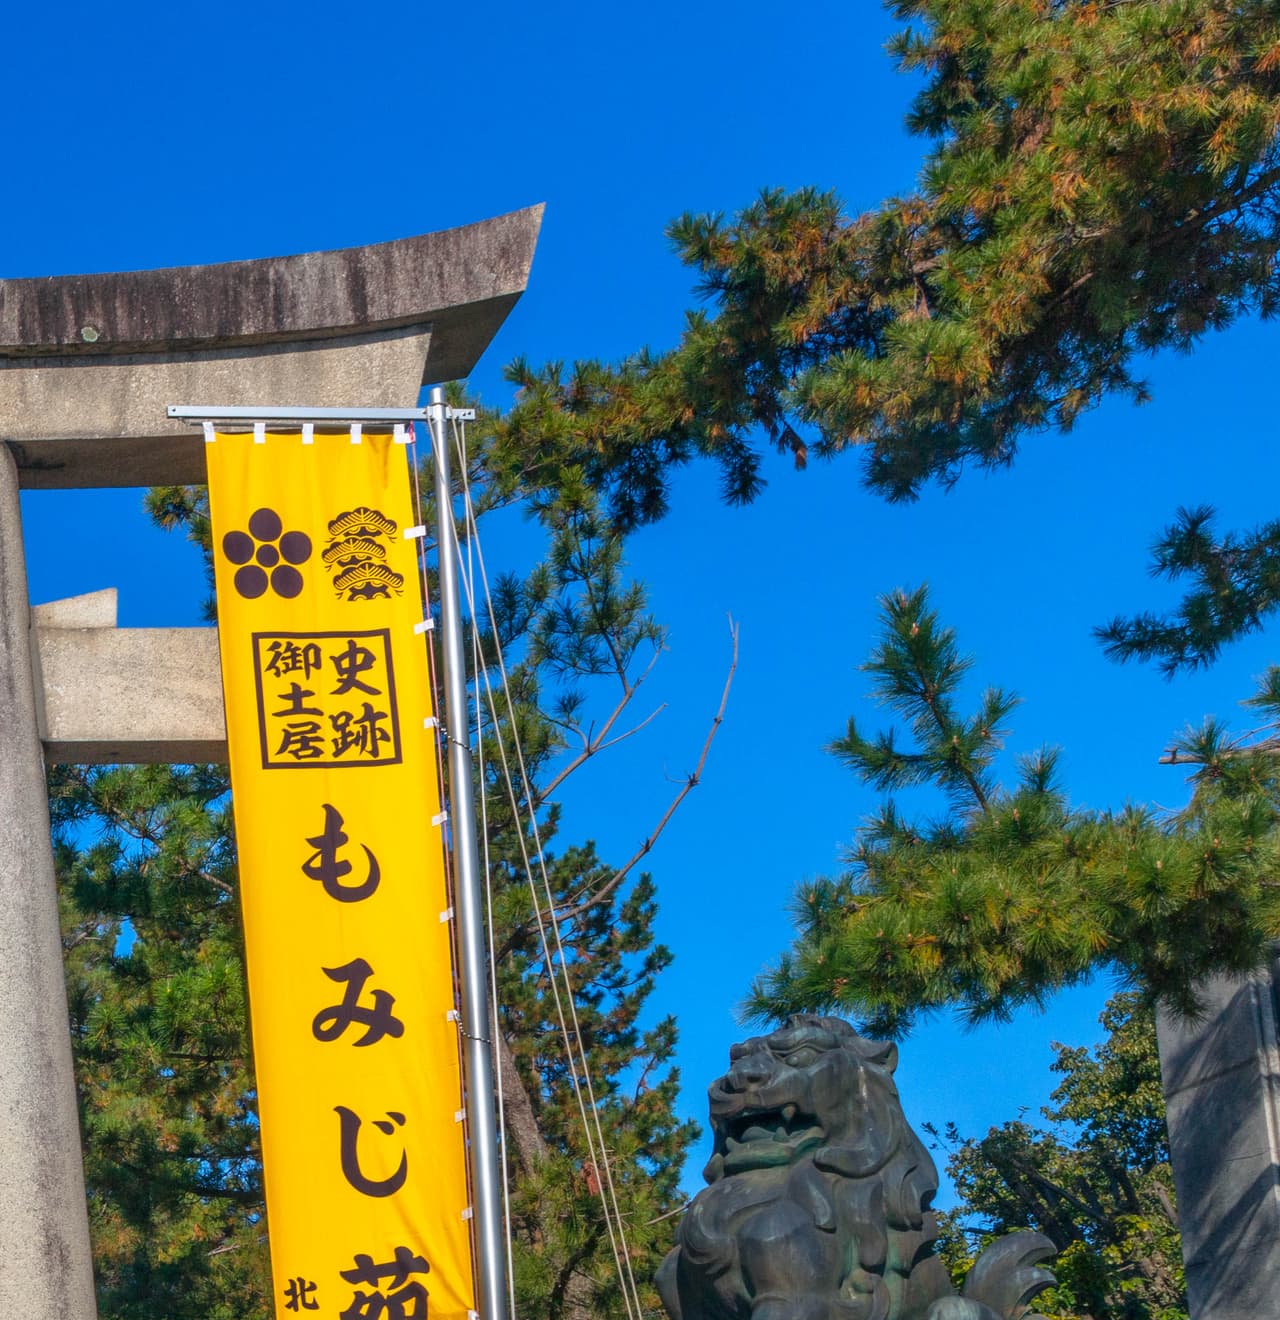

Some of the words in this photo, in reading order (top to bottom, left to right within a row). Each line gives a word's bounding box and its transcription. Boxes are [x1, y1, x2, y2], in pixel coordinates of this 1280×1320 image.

[263, 640, 326, 761] 御土居
[328, 638, 392, 760] 史跡
